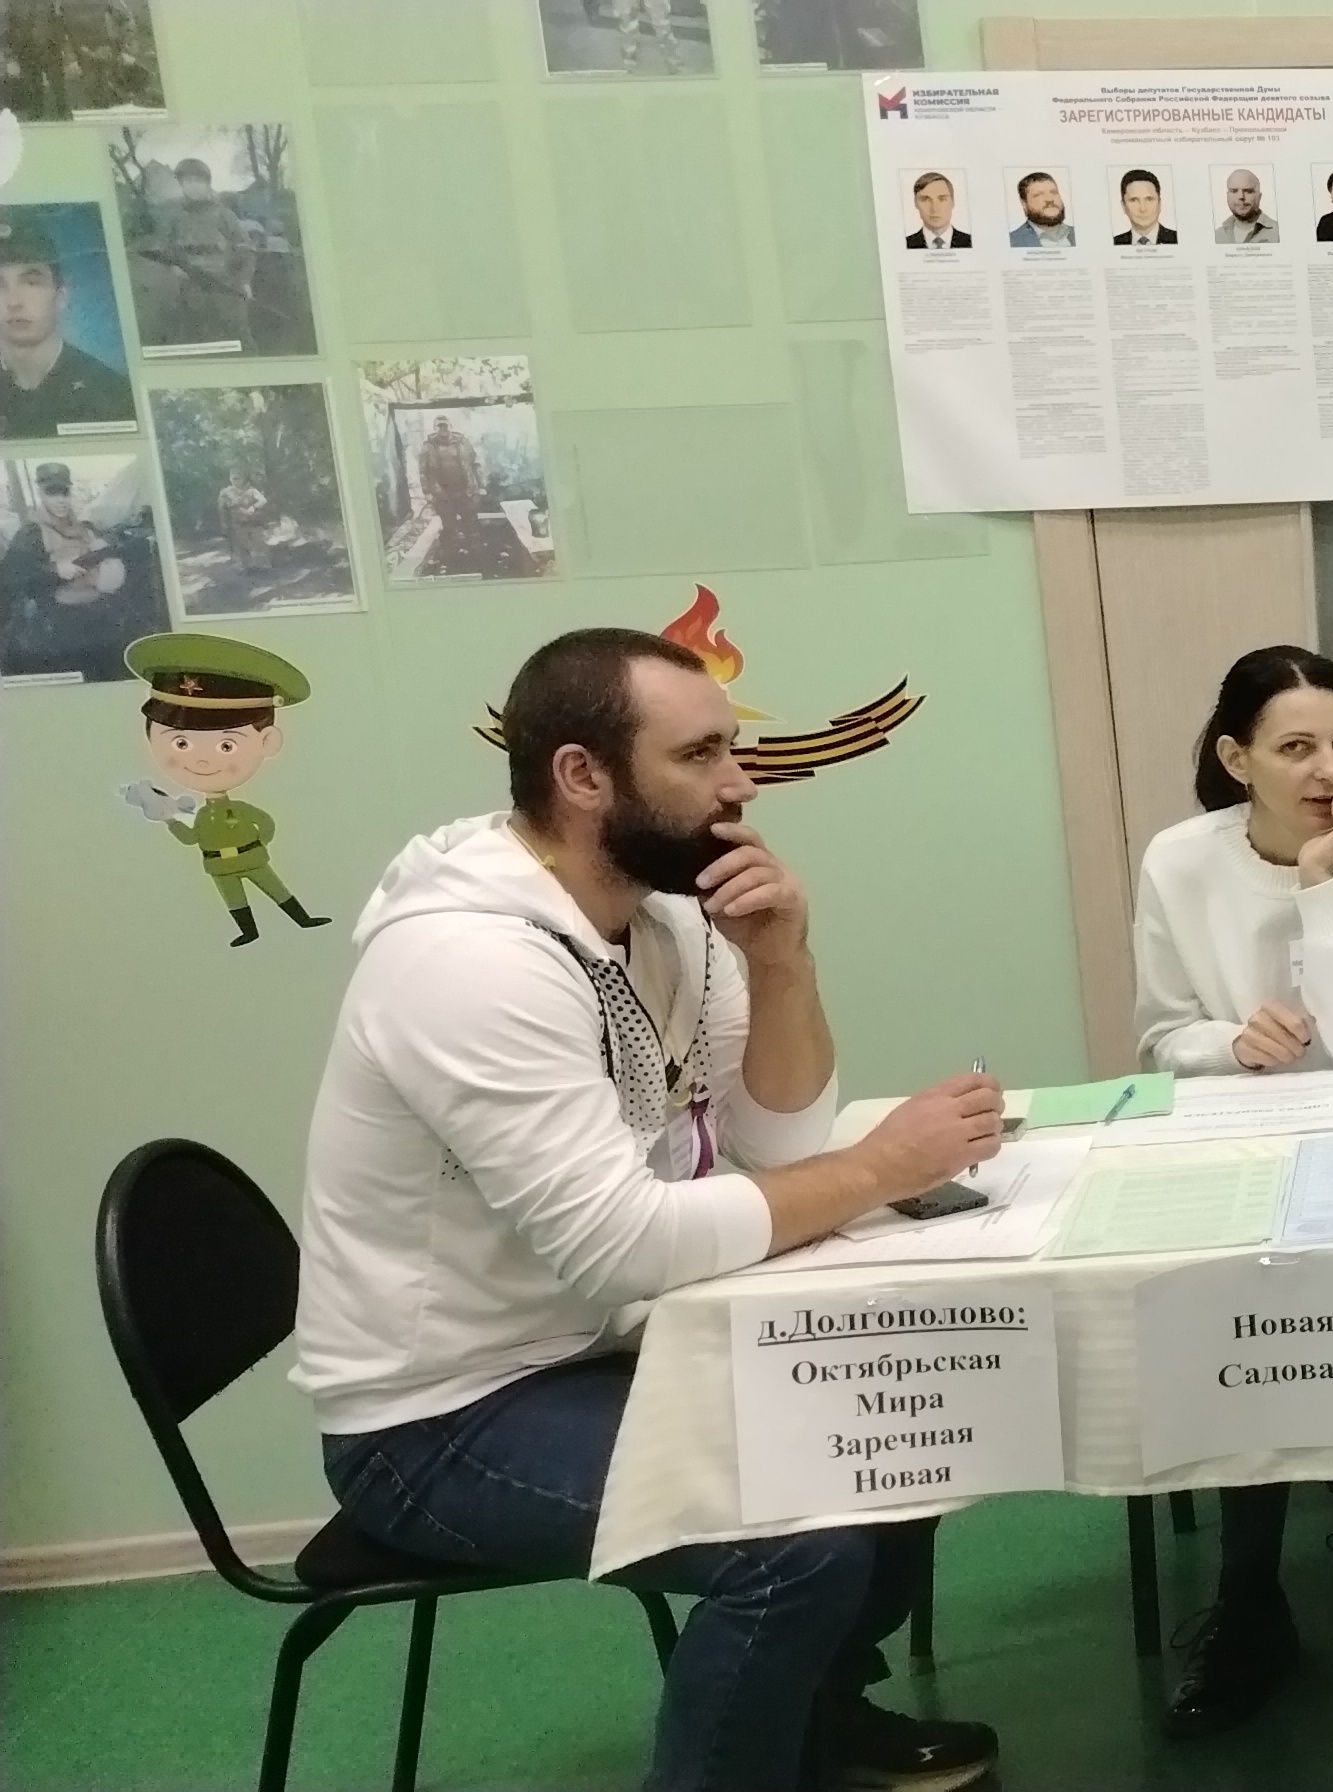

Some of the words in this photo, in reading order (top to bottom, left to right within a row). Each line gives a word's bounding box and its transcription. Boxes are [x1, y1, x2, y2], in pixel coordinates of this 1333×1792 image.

[912, 88, 999, 97] ИЗБИРАТЕЛЬНАЯ
[913, 98, 970, 106] КОМИССИЯ
[1052, 97, 1113, 105] Федерального
[1116, 96, 1156, 104] Собрания
[1212, 95, 1258, 103] Федерации
[1101, 87, 1136, 95] Выборы
[1138, 87, 1180, 95] депутатов
[1182, 86, 1255, 94] Государственной
[1257, 86, 1280, 94] Думы
[1059, 108, 1234, 123] ЗАРЕГИСТРИРОВАННЫЕ
[1237, 107, 1326, 123] КАНДИДАТЫ
[758, 1305, 1026, 1344] д.Долгополово:
[1233, 1313, 1333, 1340] Новая
[792, 1353, 1001, 1384] Октябрьская
[855, 1391, 944, 1418] Мира
[828, 1426, 974, 1460] Заречная
[854, 1466, 951, 1493] Новая
